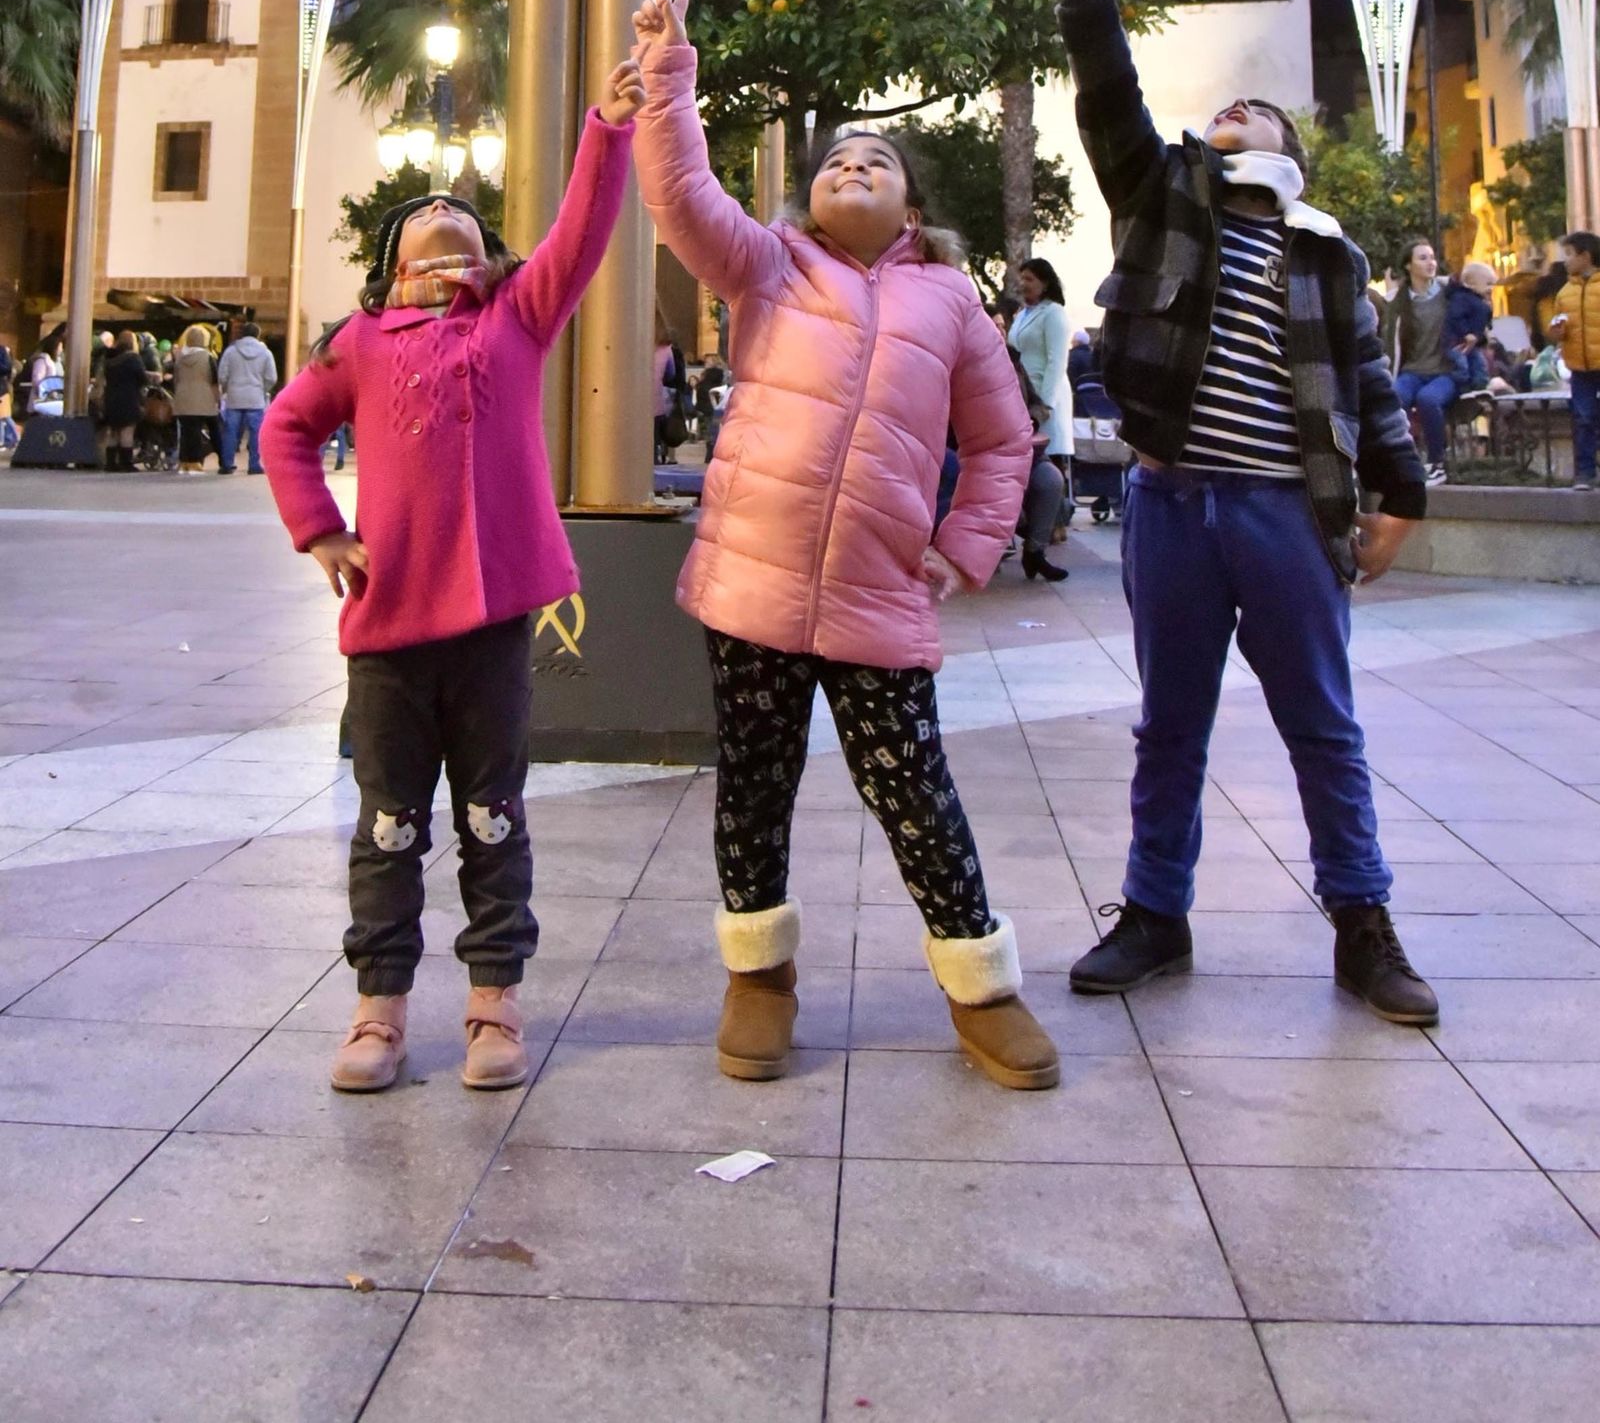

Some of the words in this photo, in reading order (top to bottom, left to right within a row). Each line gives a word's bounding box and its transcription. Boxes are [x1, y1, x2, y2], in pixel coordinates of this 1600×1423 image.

[915, 719, 930, 742] B
[874, 746, 899, 768] B
[961, 855, 977, 877] B
[725, 889, 744, 910] B
